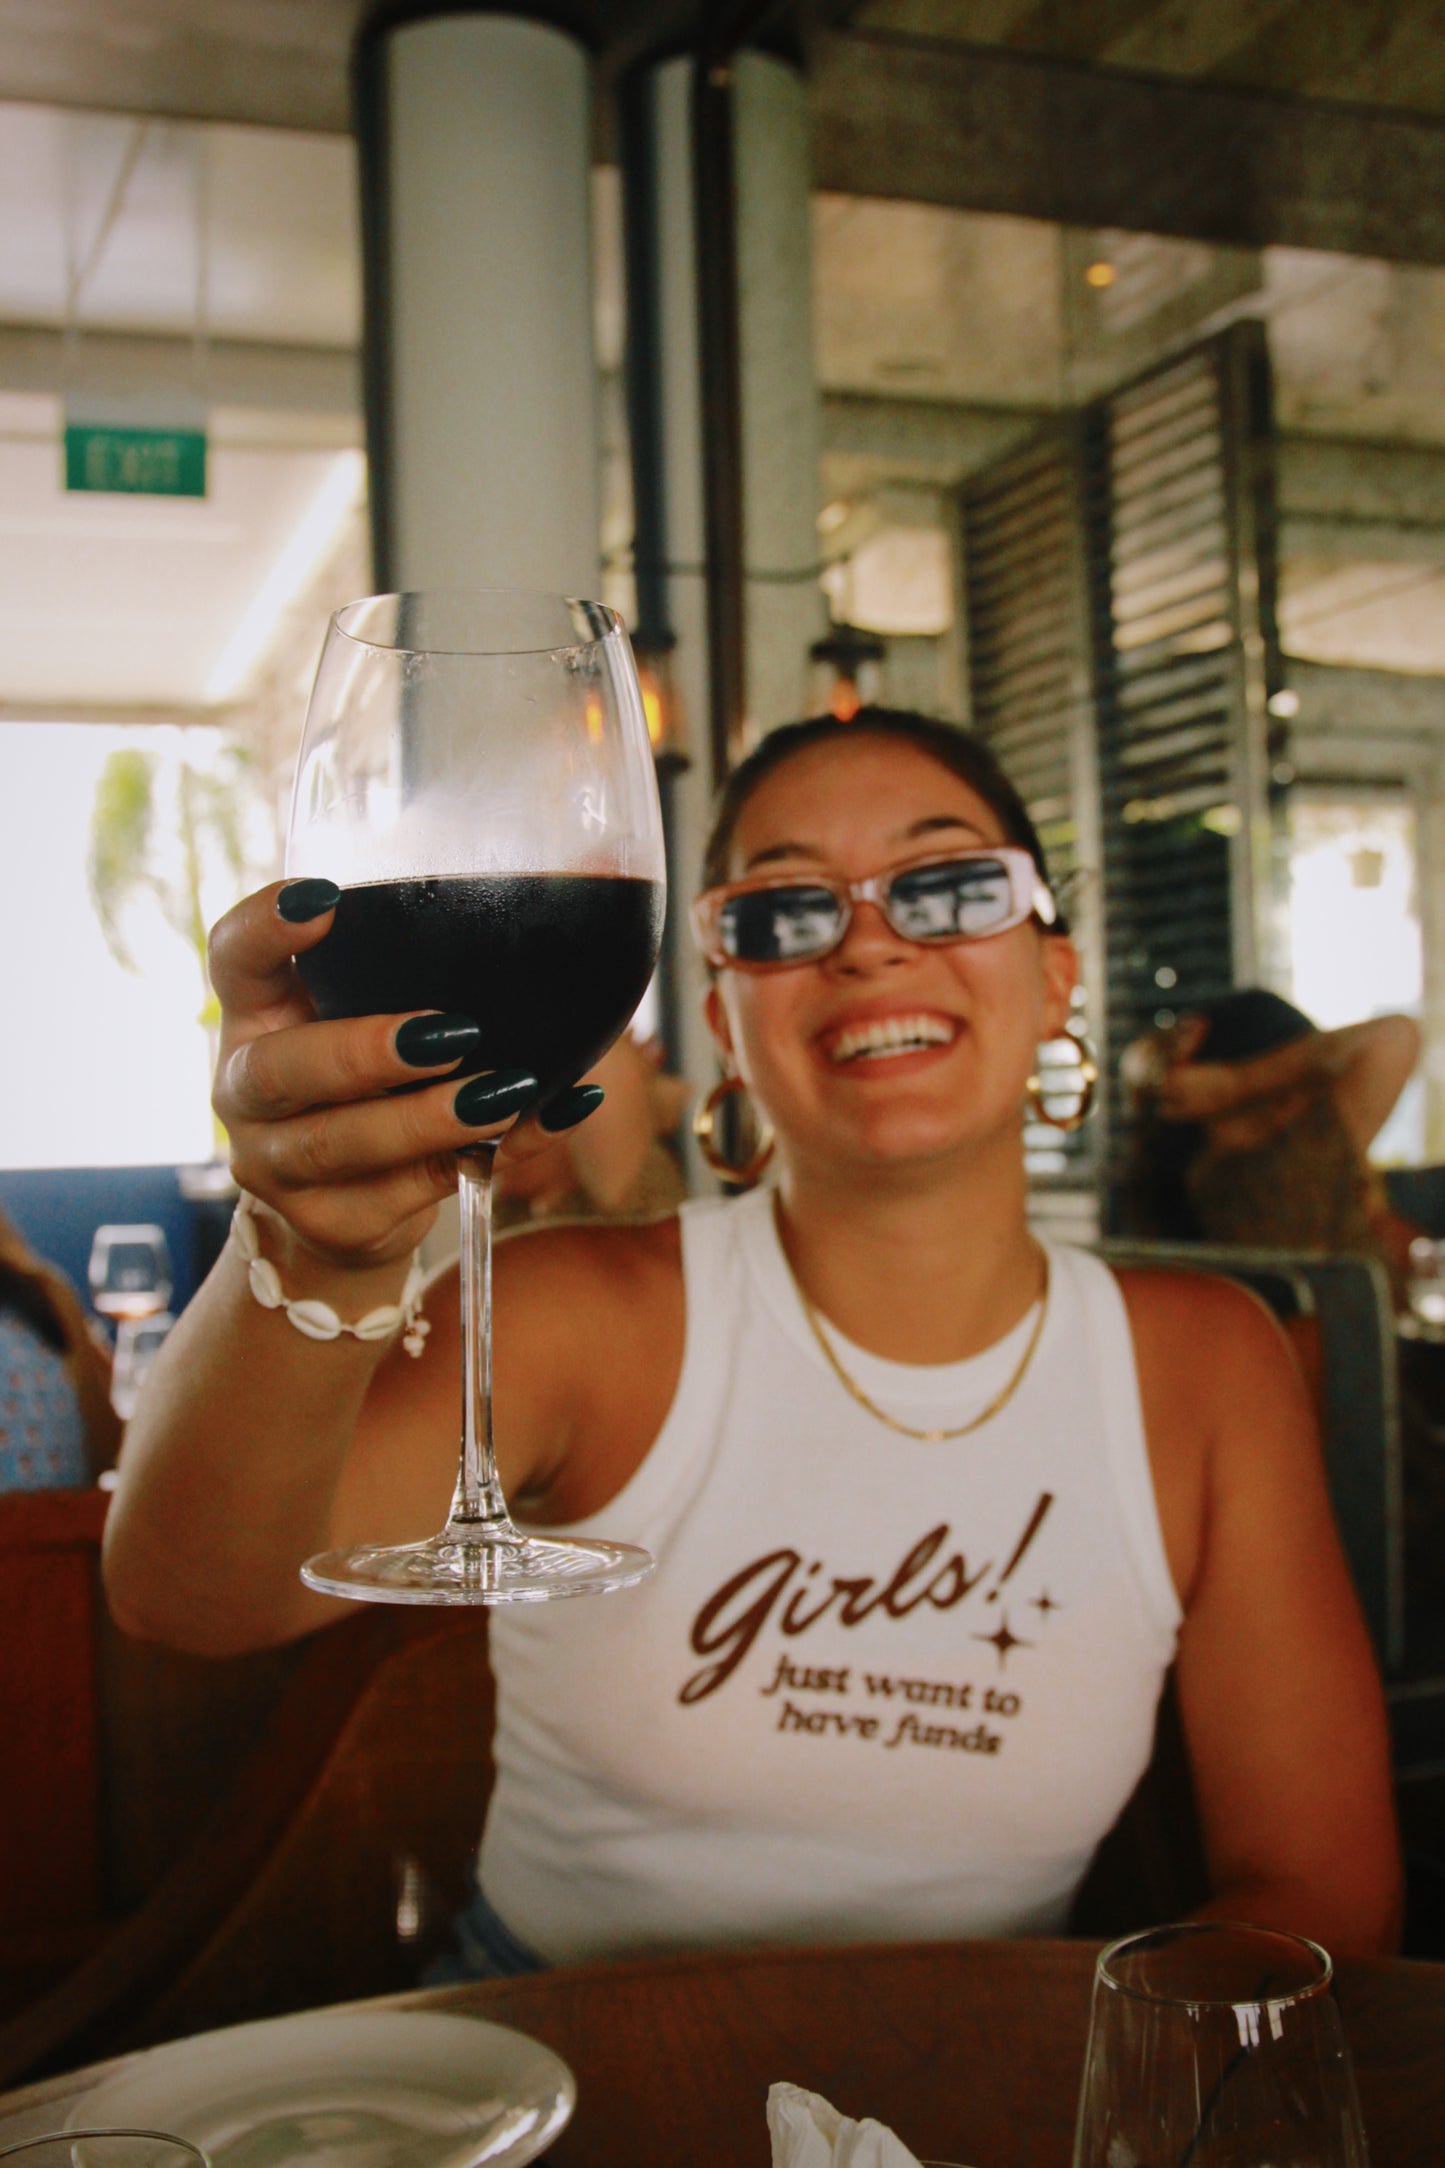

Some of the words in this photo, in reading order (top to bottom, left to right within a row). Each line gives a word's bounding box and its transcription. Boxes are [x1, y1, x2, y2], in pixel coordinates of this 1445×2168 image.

[761, 1654, 849, 1696] just
[864, 1672, 972, 1710] want
[981, 1689, 1022, 1717] to
[776, 1701, 880, 1740] have
[883, 1714, 1003, 1755] funds
